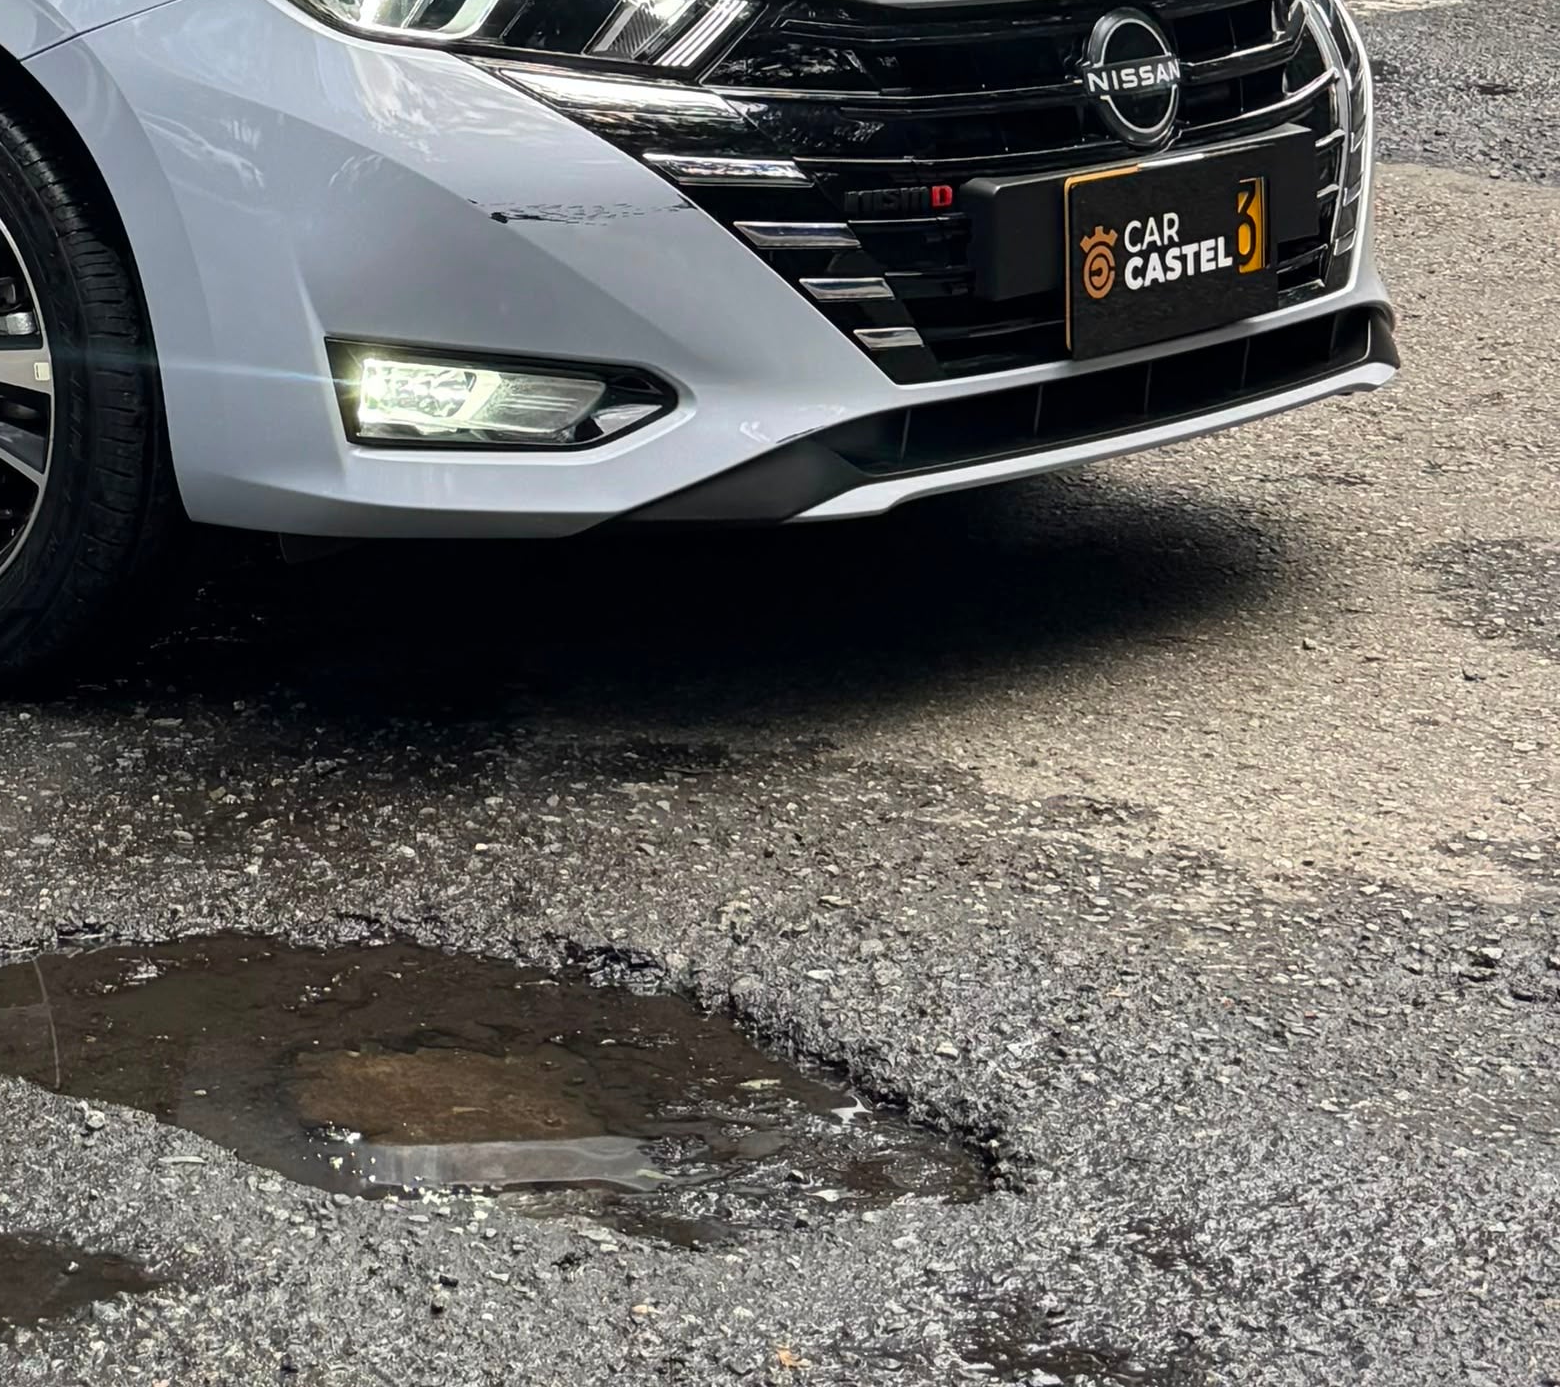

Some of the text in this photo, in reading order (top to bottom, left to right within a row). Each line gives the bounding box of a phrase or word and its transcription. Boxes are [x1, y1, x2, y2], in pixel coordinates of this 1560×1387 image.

[1087, 58, 1180, 92] NISSAN
[1124, 212, 1180, 253] CAR
[1124, 236, 1233, 290] CASTEL
